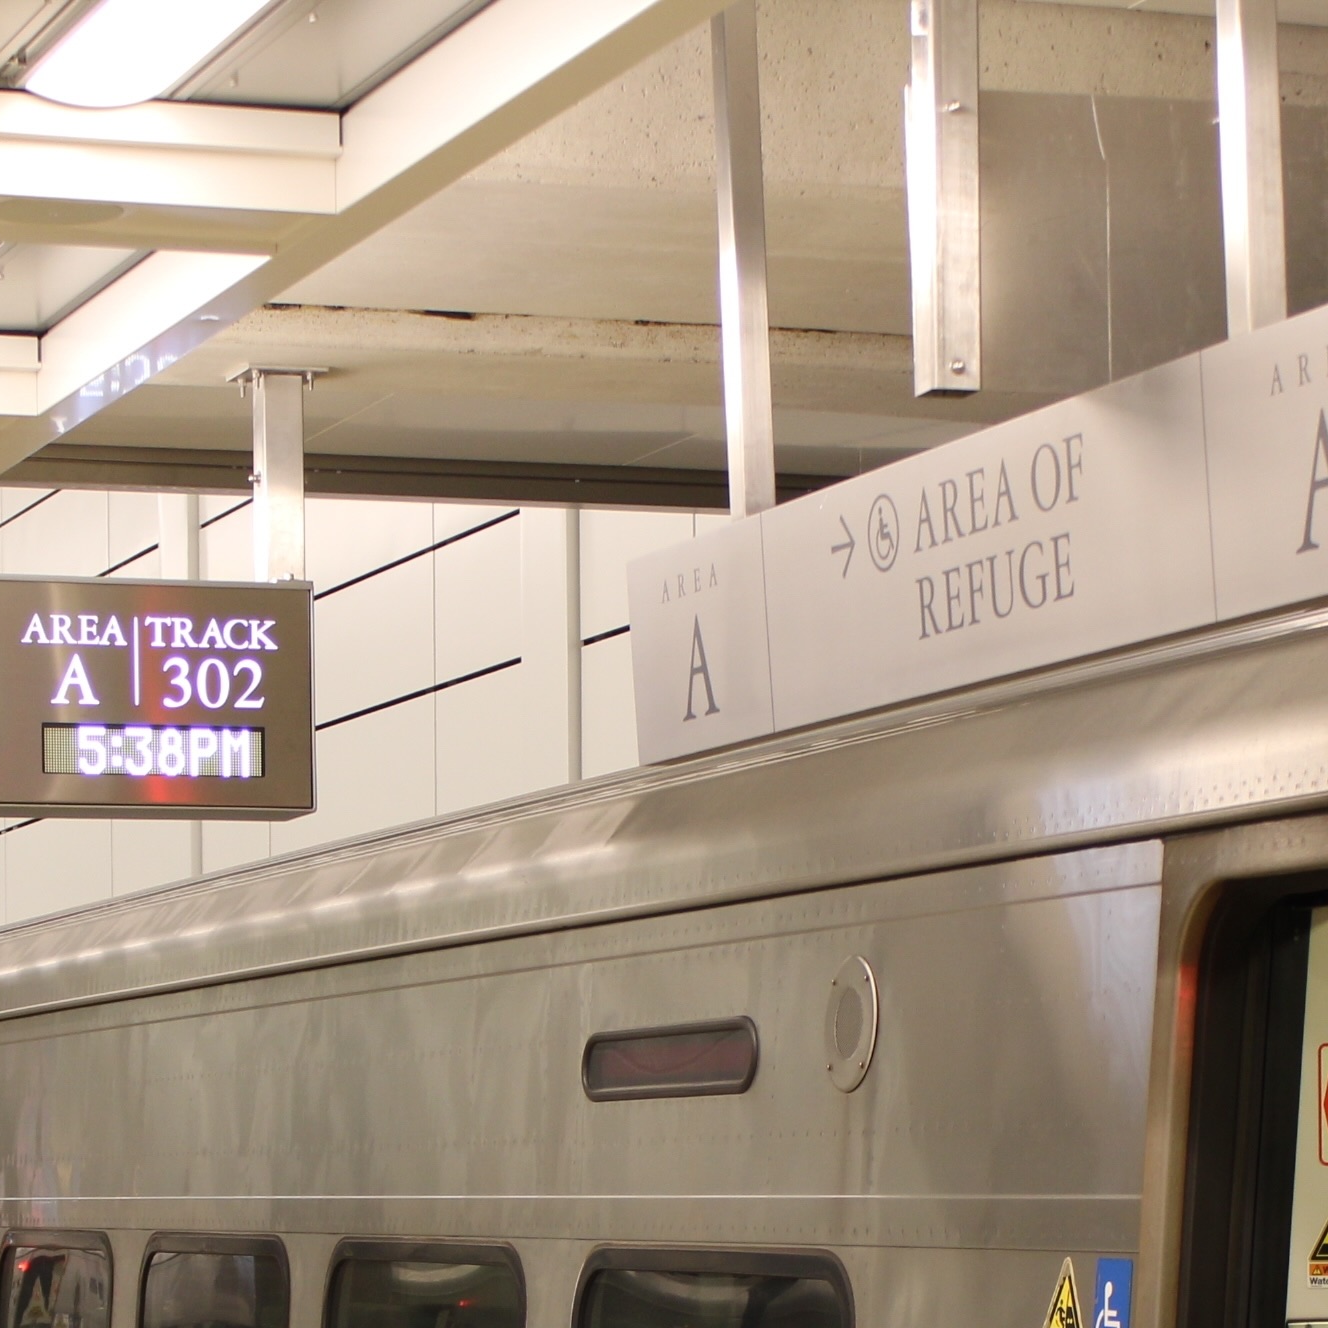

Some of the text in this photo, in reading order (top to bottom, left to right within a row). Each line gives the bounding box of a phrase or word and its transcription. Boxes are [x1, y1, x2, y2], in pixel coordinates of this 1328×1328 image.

[914, 432, 1083, 553] AREA OF
[662, 563, 718, 604] AREA
[915, 532, 1075, 640] REFUGE
[21, 613, 279, 650] AREA TRACK
[50, 653, 265, 709] A 302
[683, 613, 720, 722] A
[77, 725, 251, 778] 5:38PM
